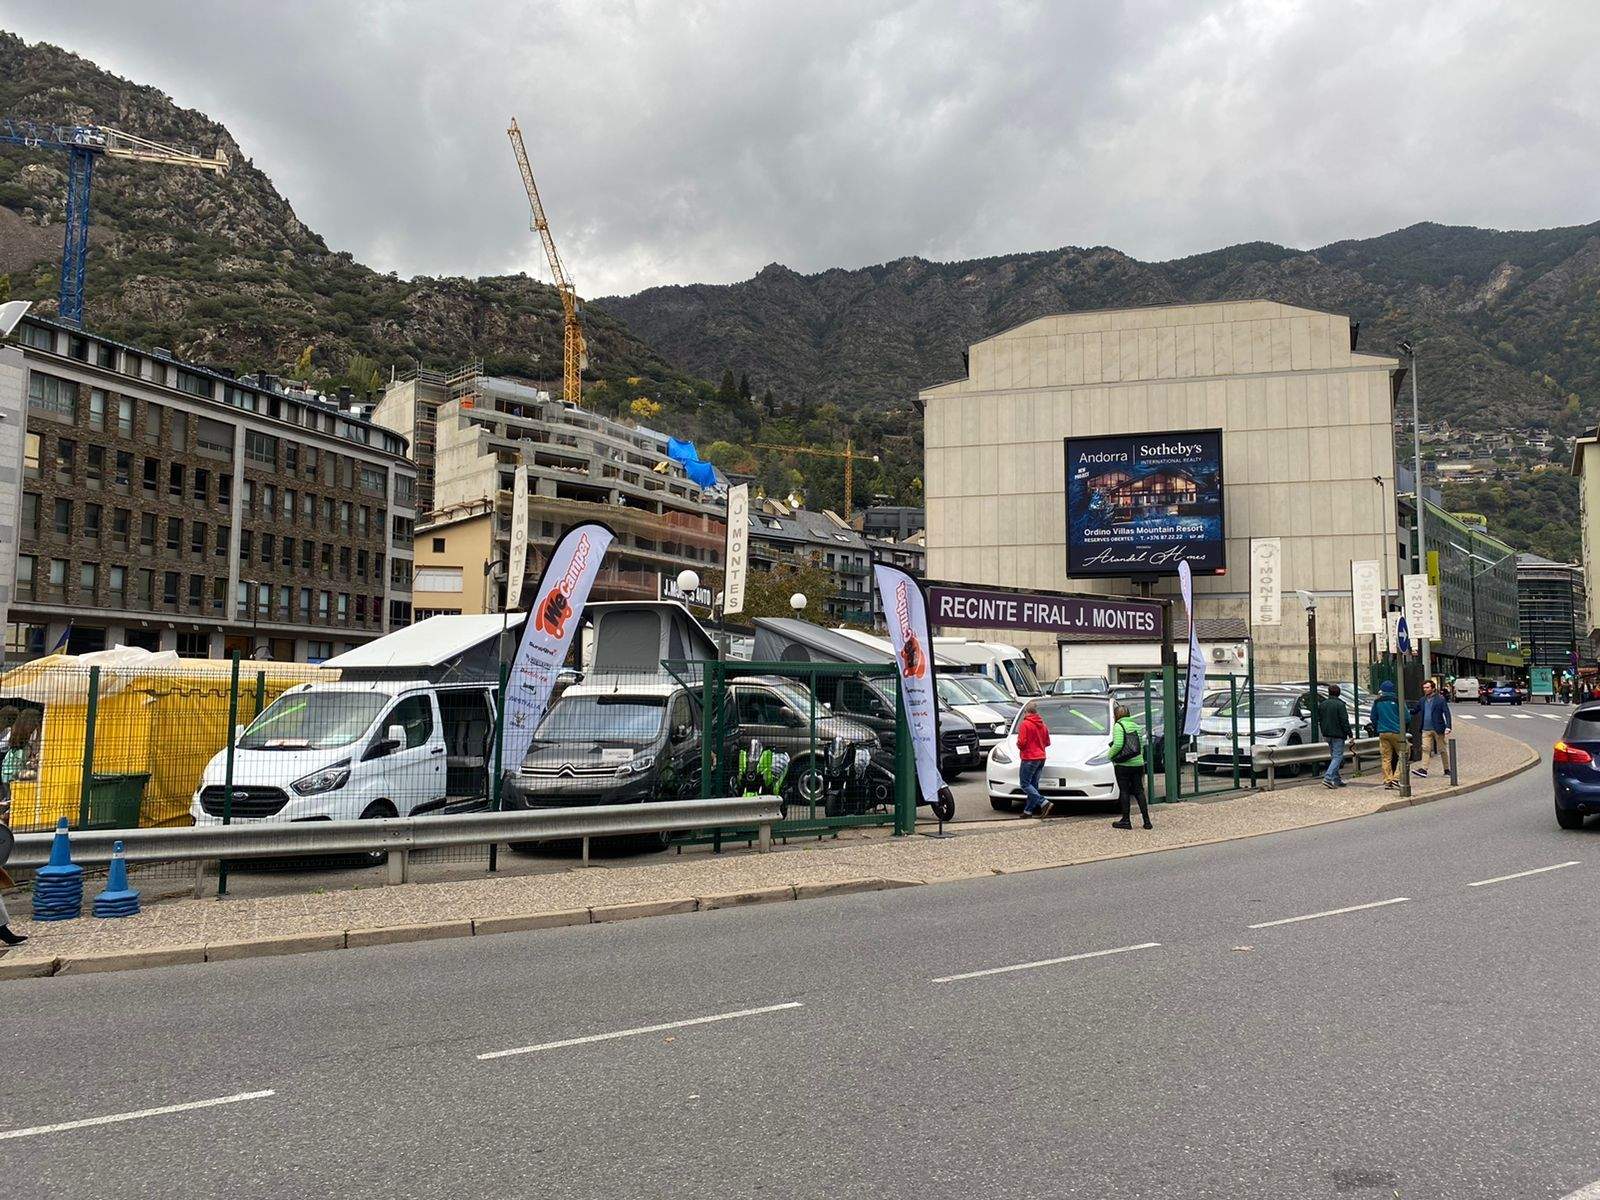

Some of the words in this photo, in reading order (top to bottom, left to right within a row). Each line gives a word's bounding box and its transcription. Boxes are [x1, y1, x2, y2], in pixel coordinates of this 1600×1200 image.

[1140, 442, 1202, 456] Sotheby's
[1079, 452, 1128, 463] Andorra
[1084, 528, 1111, 536] Ordino
[1112, 526, 1135, 535] Villas
[1136, 525, 1175, 534] Mountain
[1176, 524, 1204, 532] Resort
[1149, 545, 1206, 566] Hmes
[940, 596, 1017, 621] RECINTE
[1023, 602, 1071, 626] FIRAL
[1075, 608, 1088, 627] J.
[1093, 608, 1155, 631] MONTES
